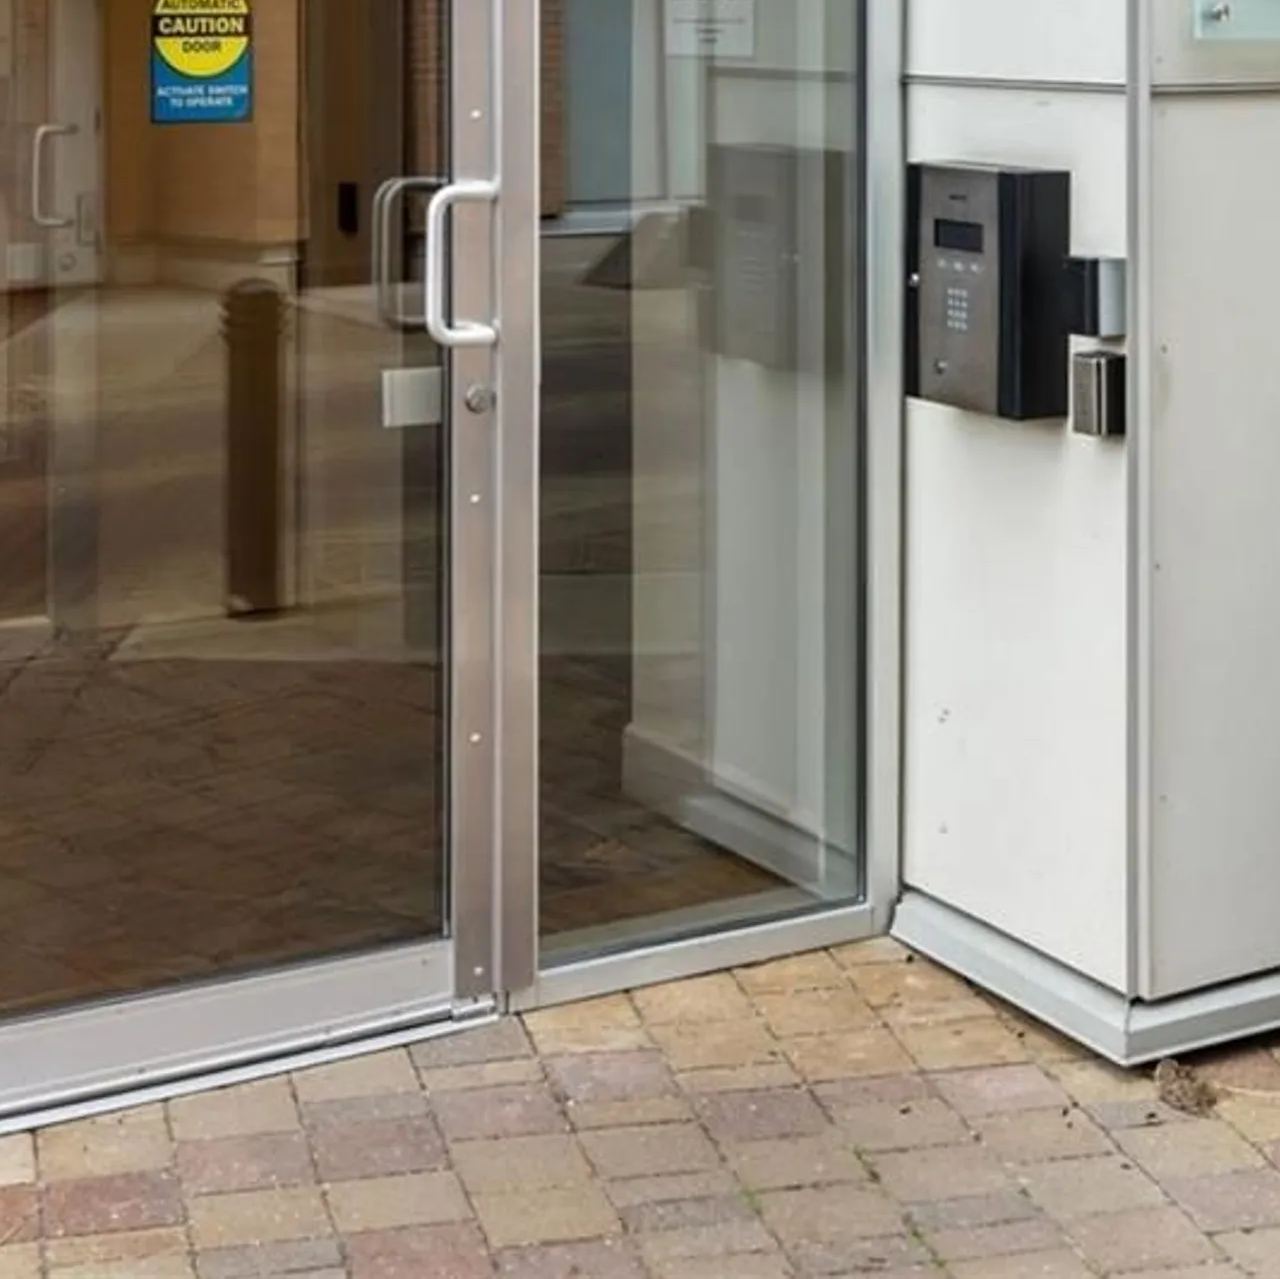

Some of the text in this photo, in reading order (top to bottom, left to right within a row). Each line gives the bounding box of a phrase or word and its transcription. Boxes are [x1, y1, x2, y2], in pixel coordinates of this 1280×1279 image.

[158, 16, 245, 34] CAUTION
[181, 40, 223, 53] DOOR
[156, 84, 205, 97] ACTIVATE
[186, 96, 234, 108] OPERATE
